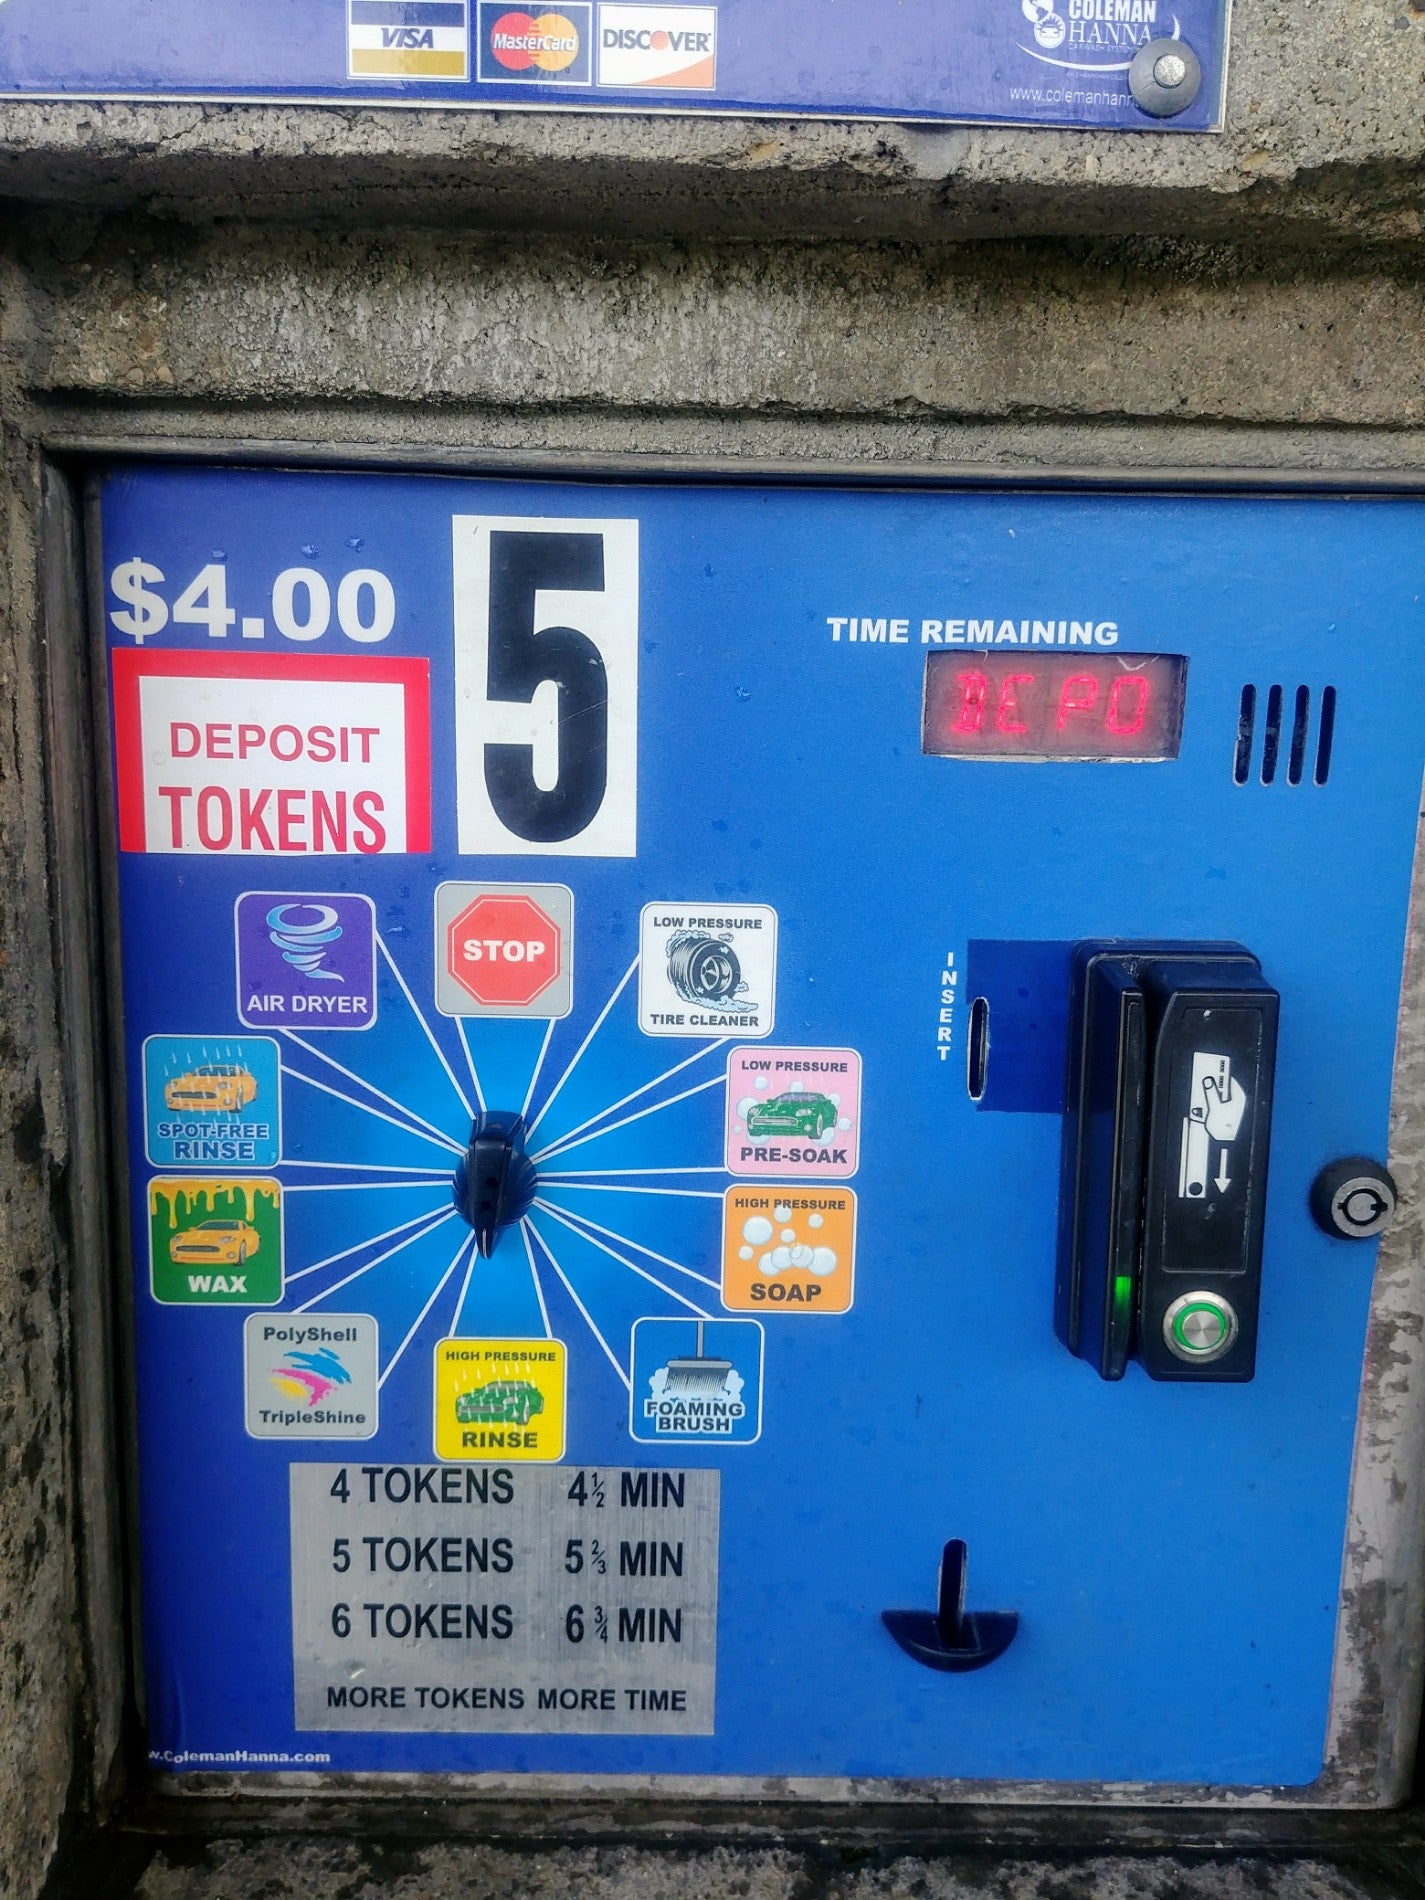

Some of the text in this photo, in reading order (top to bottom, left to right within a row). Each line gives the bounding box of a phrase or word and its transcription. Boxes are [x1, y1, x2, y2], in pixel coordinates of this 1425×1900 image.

[1068, 0, 1156, 23] COLEMAN
[381, 27, 434, 48] VISA
[492, 33, 577, 52] MasterCard
[603, 29, 711, 52] DISCOVER
[1068, 20, 1151, 46] HANNA
[110, 557, 396, 644] $4.00
[826, 617, 1119, 645] TIME REMAINING
[483, 530, 608, 843] 5
[170, 722, 380, 763] DEPOSIT
[158, 785, 387, 855] TOKENS
[653, 917, 763, 930] LOW PRESSURE
[463, 940, 545, 962] STOP
[247, 995, 368, 1014] AIR DRYER
[937, 951, 957, 1061] INSERT
[650, 1014, 759, 1027] TIRE CLEANER
[741, 1060, 848, 1073] LOW PRESSURE
[157, 1122, 270, 1140] SPOT-FREE
[173, 1141, 256, 1161] RINSE
[740, 1147, 848, 1164] PRE-SOAK
[734, 1198, 846, 1211] HIGH PRESSURE
[188, 1275, 248, 1293] WAX
[750, 1283, 822, 1303] SOAP
[263, 1326, 358, 1344] PolyShell
[446, 1351, 556, 1362] HIGH PRESSURE
[259, 1411, 366, 1425] TripleShine
[646, 1402, 743, 1417] FOAMING
[658, 1417, 731, 1432] BRUSH
[462, 1432, 538, 1448] RINSE
[330, 1468, 350, 1503] 4
[362, 1467, 514, 1503] TOKENS
[621, 1471, 685, 1508] MIN
[332, 1538, 351, 1573] 5
[362, 1537, 514, 1573] TOKENS
[620, 1541, 683, 1576] MIN
[331, 1603, 351, 1638] 6
[363, 1603, 514, 1639] TOKENS
[618, 1608, 682, 1643] MIN
[327, 1687, 687, 1711] MORE TOKENS MORE TIME
